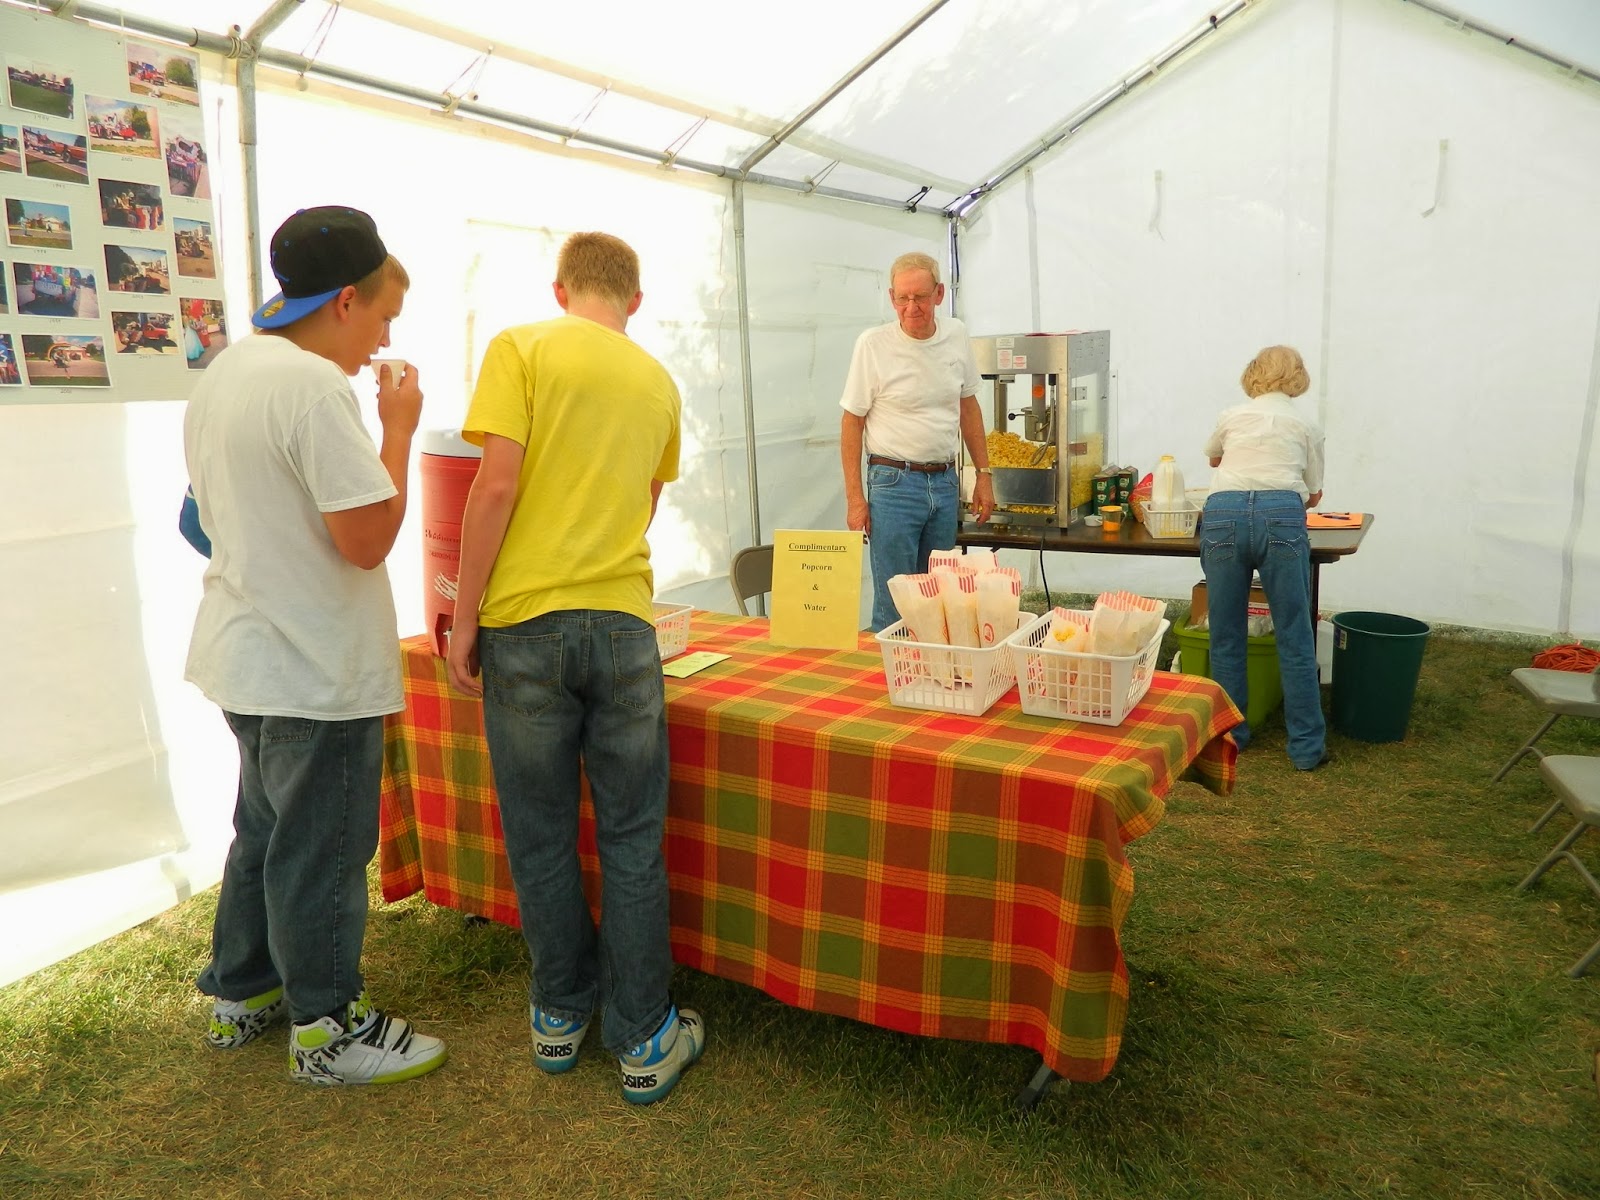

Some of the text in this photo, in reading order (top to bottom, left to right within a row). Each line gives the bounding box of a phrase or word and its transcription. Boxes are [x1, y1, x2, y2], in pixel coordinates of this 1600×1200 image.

[788, 542, 848, 552] Complimentary
[801, 562, 833, 572] Popcorn
[812, 583, 819, 591] &
[803, 603, 827, 612] Water
[536, 1042, 573, 1058] OSIRIS
[622, 1073, 658, 1089] OSIRIS
